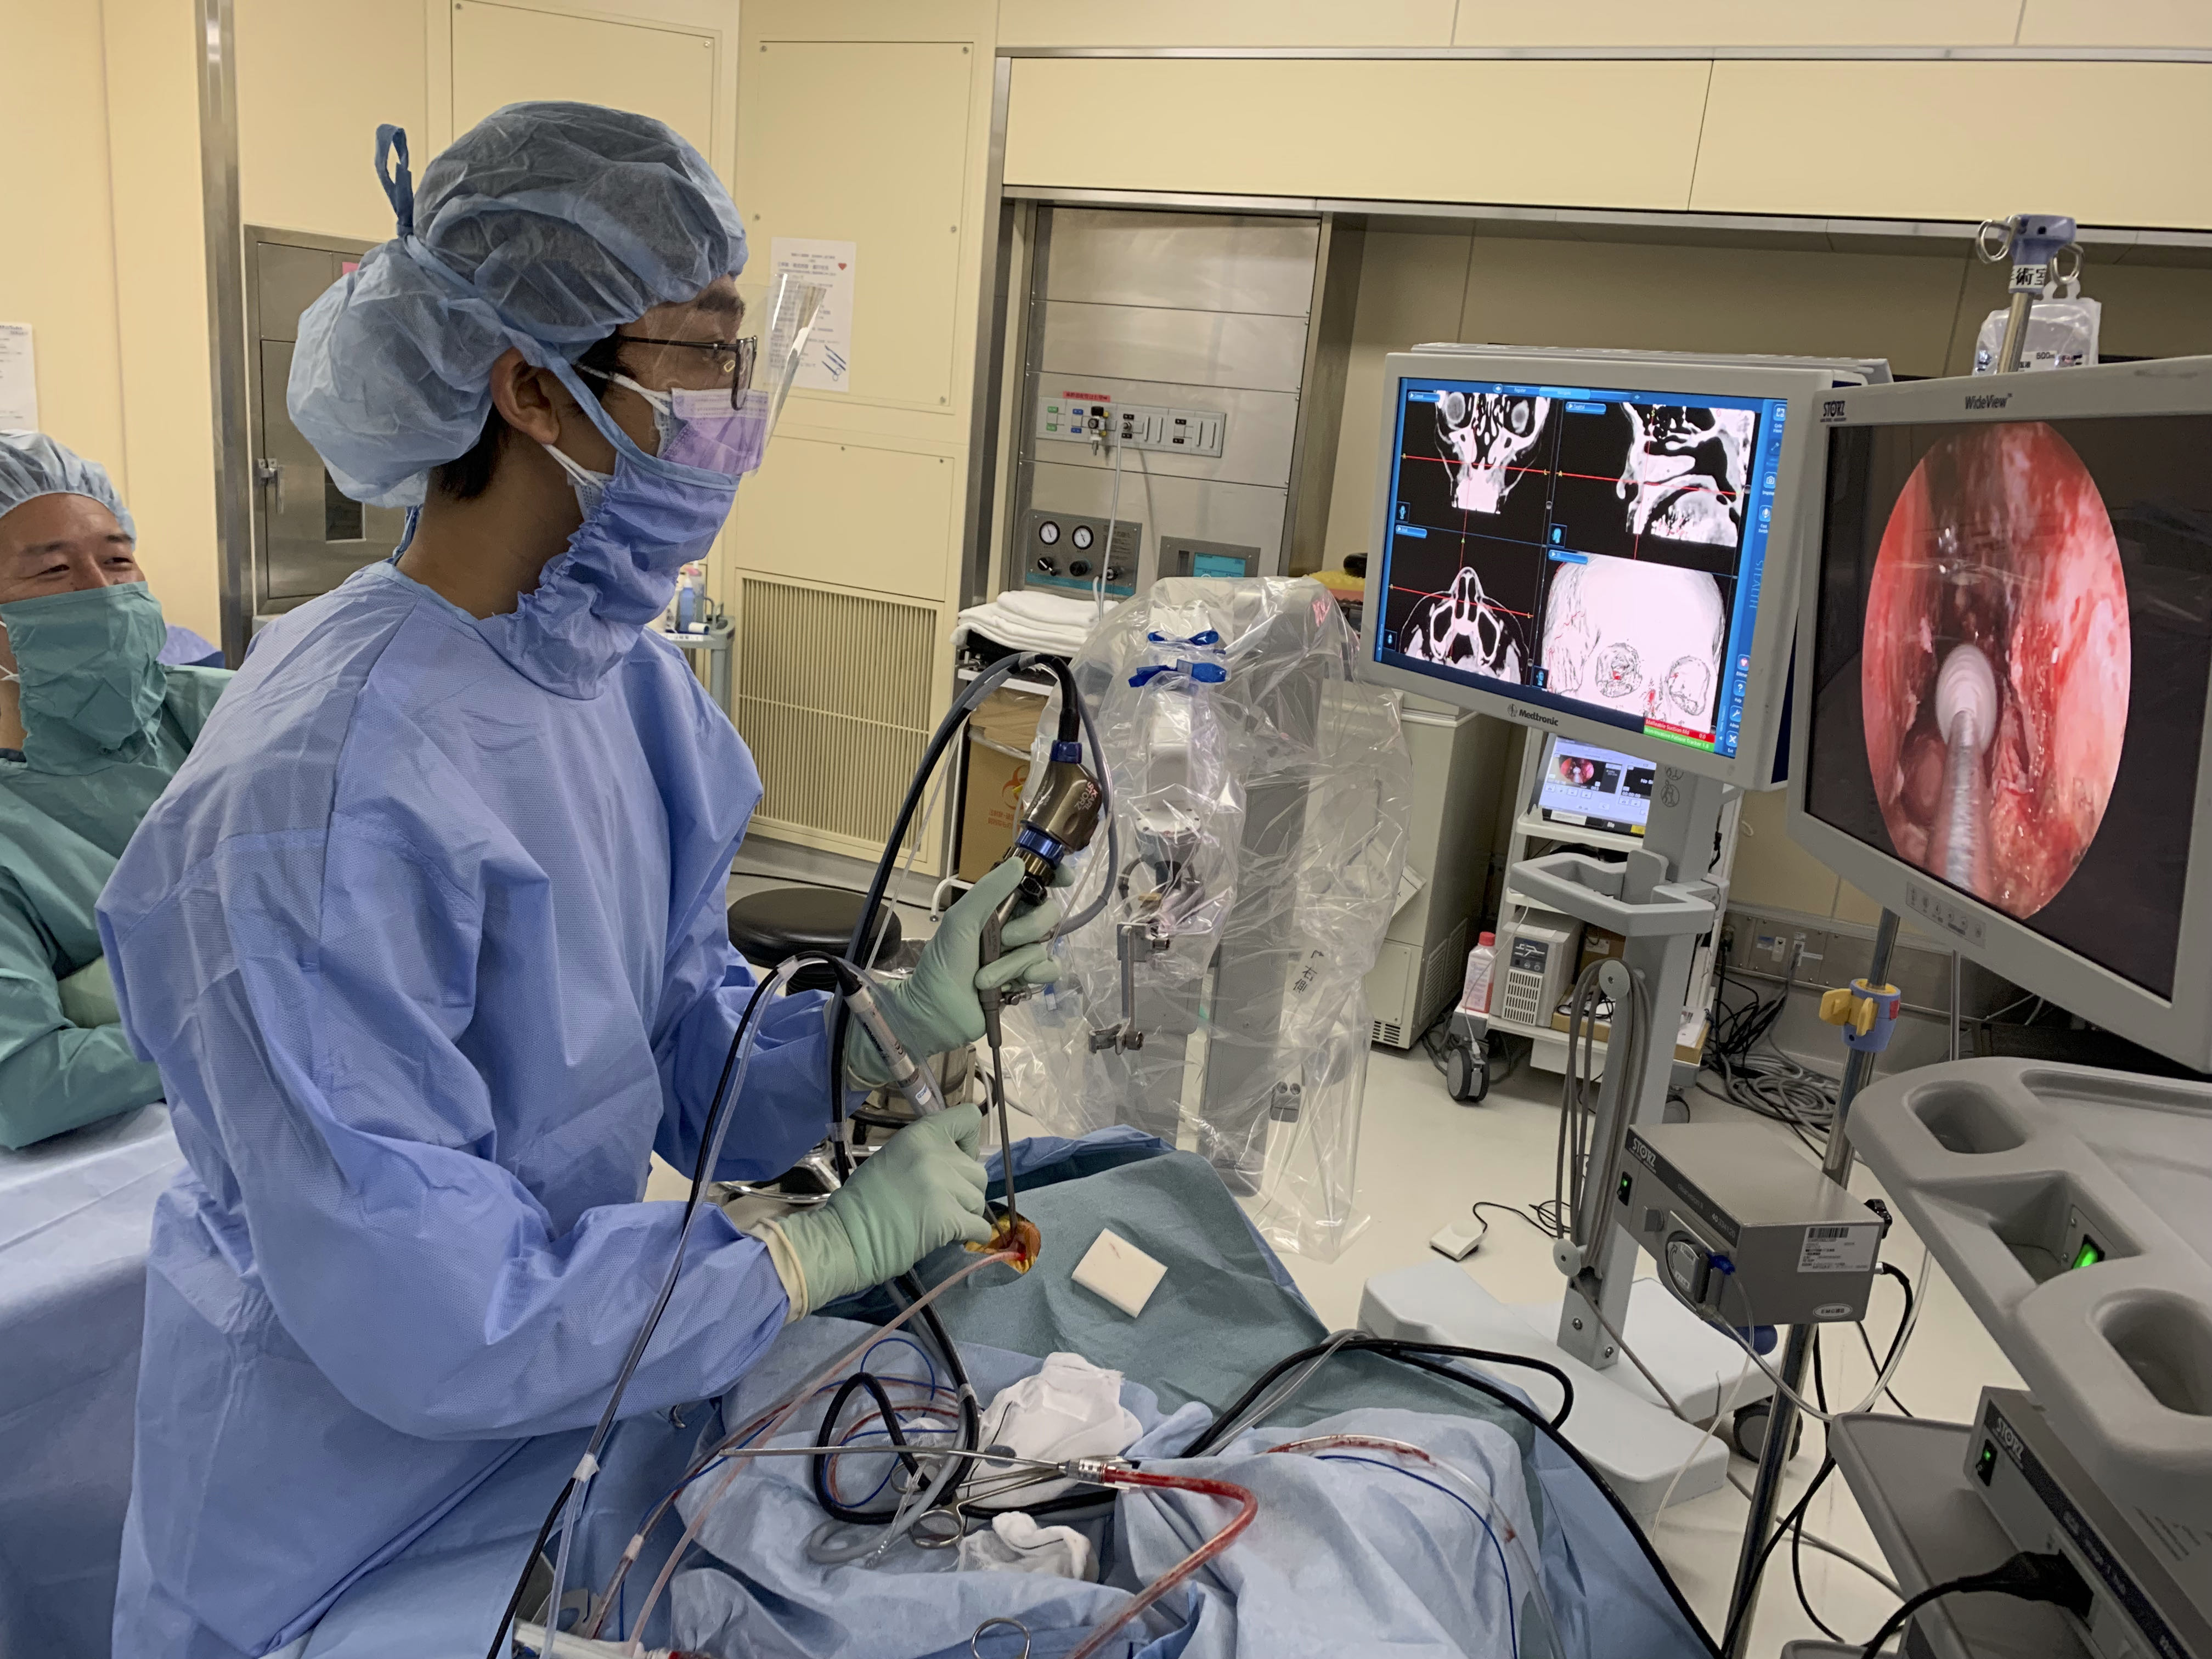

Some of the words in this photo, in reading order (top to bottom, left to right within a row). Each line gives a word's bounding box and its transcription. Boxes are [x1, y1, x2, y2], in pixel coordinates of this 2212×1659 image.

[1823, 400, 1846, 417] STORZ
[1519, 709, 1559, 726] Medtronic
[1074, 781, 1094, 811] STORZ
[1082, 788, 1099, 810] KARL
[1293, 965, 1318, 994] 右側
[1632, 1137, 1657, 1167] STORZ
[1997, 1417, 2024, 1460] STORZ
